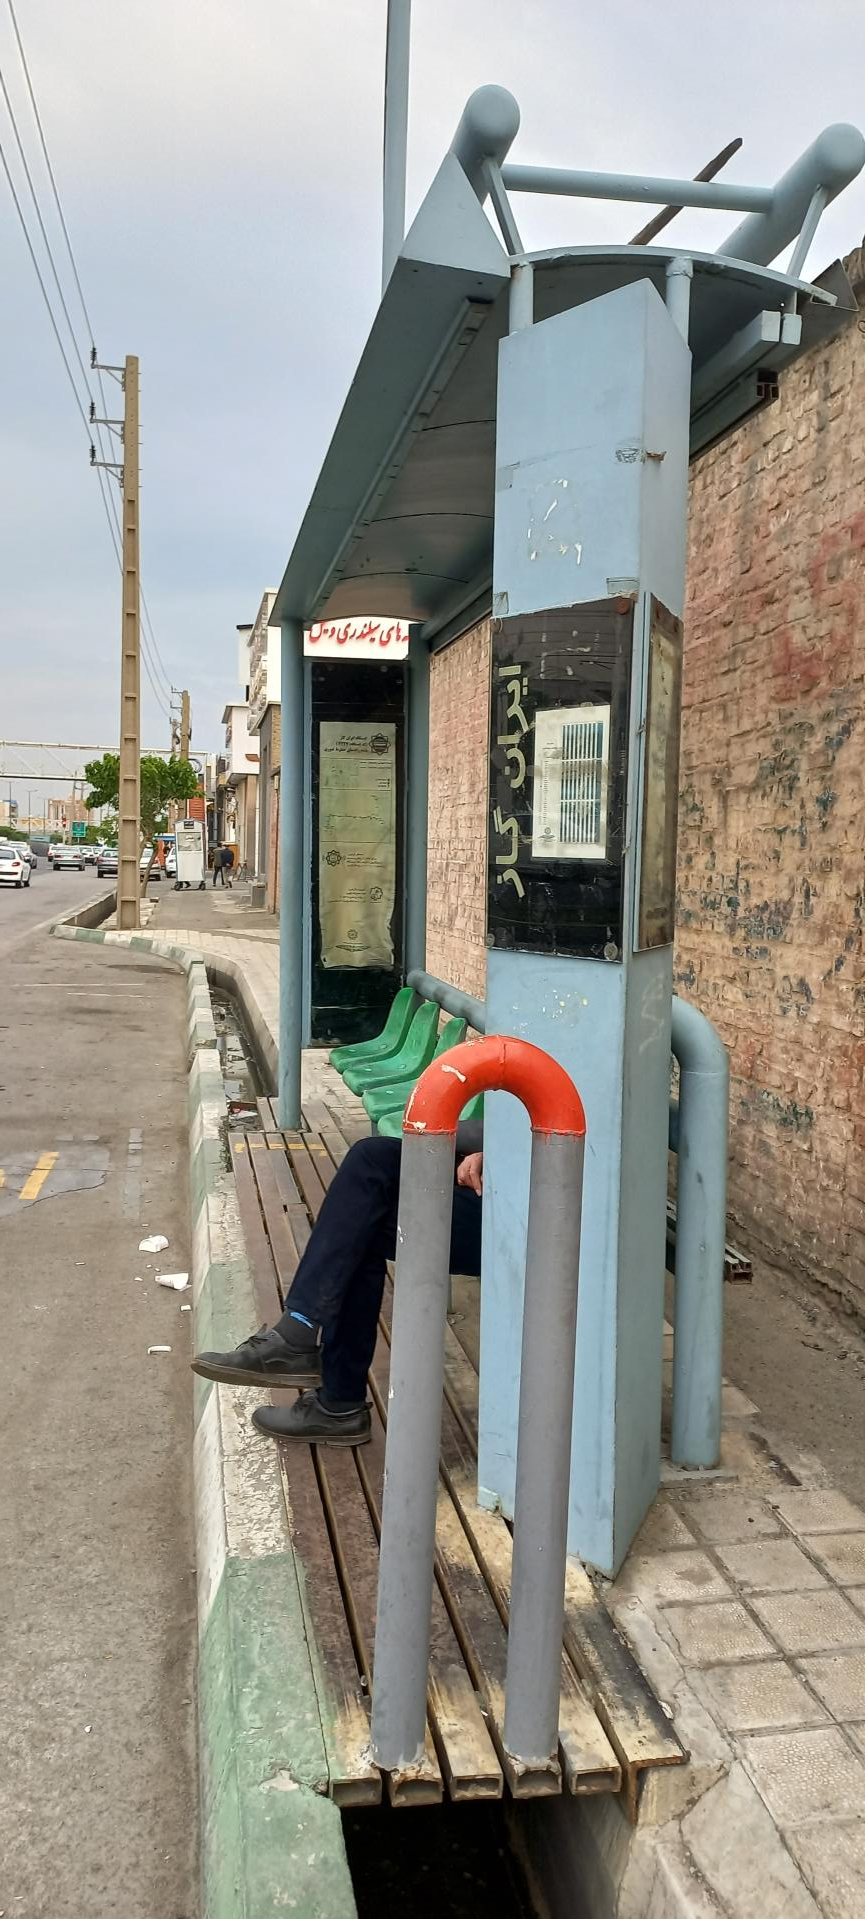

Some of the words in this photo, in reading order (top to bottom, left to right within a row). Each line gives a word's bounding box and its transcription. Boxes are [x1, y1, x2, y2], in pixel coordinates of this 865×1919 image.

[336, 620, 381, 644] سیلندری
[497, 665, 528, 789] ایران
[493, 805, 526, 899] گاز
